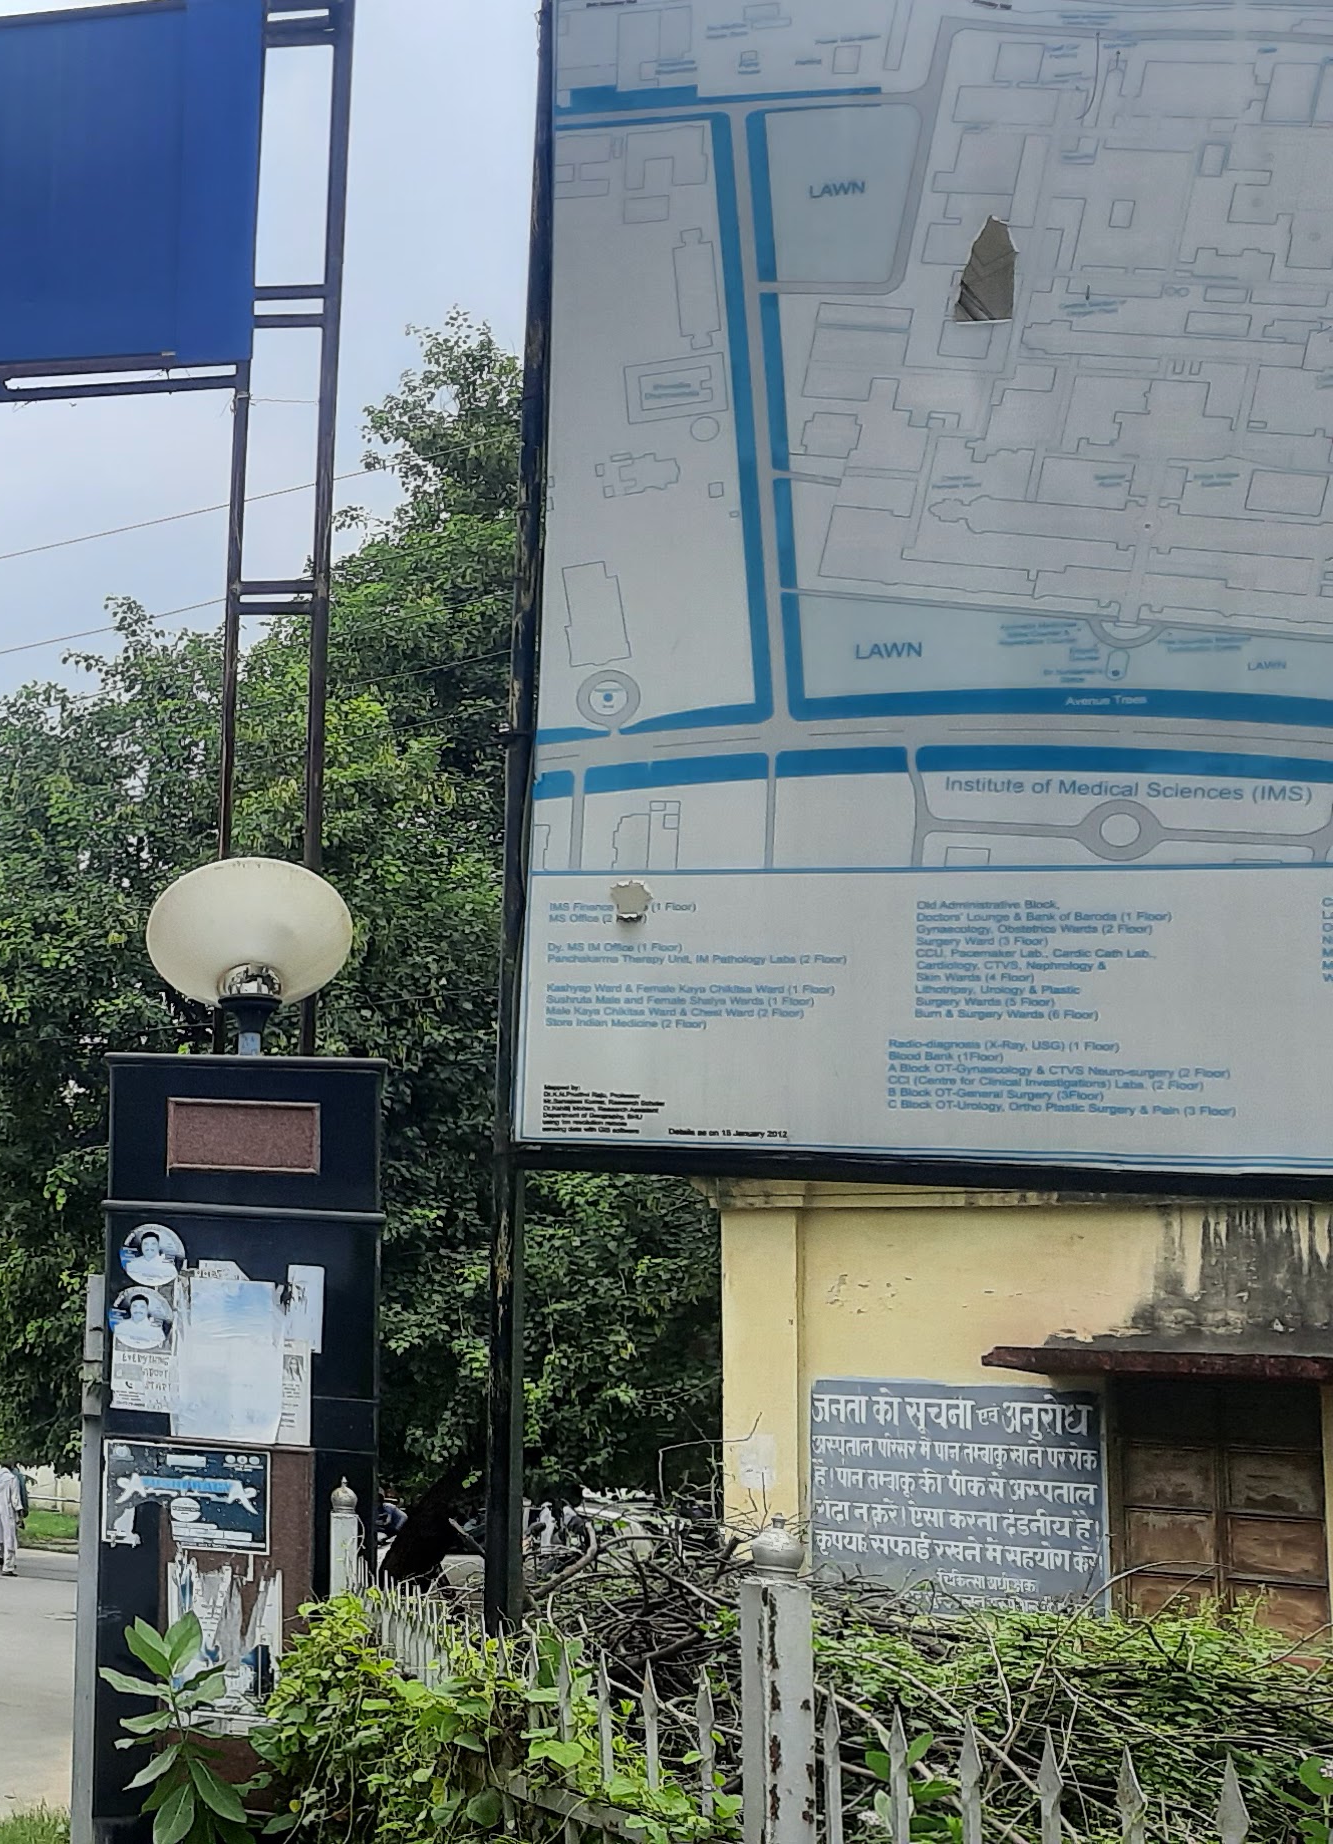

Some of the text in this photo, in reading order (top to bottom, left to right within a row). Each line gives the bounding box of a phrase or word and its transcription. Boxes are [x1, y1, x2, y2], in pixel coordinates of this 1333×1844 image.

[809, 181, 865, 198] LAWN
[854, 640, 923, 661] LAWN
[1247, 660, 1287, 671] LAWN
[945, 776, 1312, 806] Institute of Medical Sciences (IMS)
[888, 1039, 1120, 1053] Radio-diagnosis (X-Ray, USG) (1 Floor)
[888, 1051, 922, 1061] Blood
[925, 1051, 953, 1061] Bank
[888, 1063, 897, 1073] A
[900, 1063, 930, 1073] Block
[1036, 1065, 1045, 1075] &
[1049, 1065, 1084, 1075] CTVS
[1088, 1066, 1174, 1079] Neuro-surgery
[1194, 1068, 1231, 1080] Floor)
[888, 1075, 910, 1085] CCI
[913, 1075, 956, 1086] (Centre
[960, 1076, 975, 1086] for
[979, 1076, 1022, 1086] Clinical
[1025, 1077, 1111, 1090] Investigations)
[1151, 1080, 1164, 1092] (2
[1168, 1080, 1204, 1092] Floor)
[887, 1088, 897, 1097] B
[900, 1088, 931, 1097] Block
[935, 1088, 1003, 1098] OT-General
[1006, 1089, 1053, 1101] Surgery
[887, 1100, 1236, 1118] C Block OT-Urology, Ortho Plastic Surgery & Pain (3 Floor)
[668, 1128, 695, 1137] Details
[697, 1129, 707, 1137] as
[708, 1129, 719, 1137] on
[732, 1130, 765, 1140] January
[766, 1130, 788, 1139] 2012
[812, 1387, 1094, 1441] जनता को सूचना एवं अनुरोध
[812, 1435, 876, 1458] अस्पताल
[875, 1432, 918, 1460] परिसर
[934, 1441, 962, 1462] पान
[1009, 1440, 1046, 1469] खाने
[1046, 1447, 1068, 1470] पर
[1067, 1442, 1099, 1471] रोक
[835, 1467, 867, 1489] पान
[918, 1467, 945, 1495] की
[946, 1469, 986, 1498] पीक
[986, 1471, 1008, 1500] से
[1009, 1479, 1099, 1506] अस्पताल
[853, 1502, 870, 1522] न
[908, 1500, 947, 1529] ऐसा
[947, 1509, 1001, 1533] करना
[1001, 1508, 1074, 1538] दंडनीय
[869, 1531, 932, 1560] सफाई
[933, 1536, 984, 1563] रखने
[1005, 1541, 1073, 1572] सहयोग
